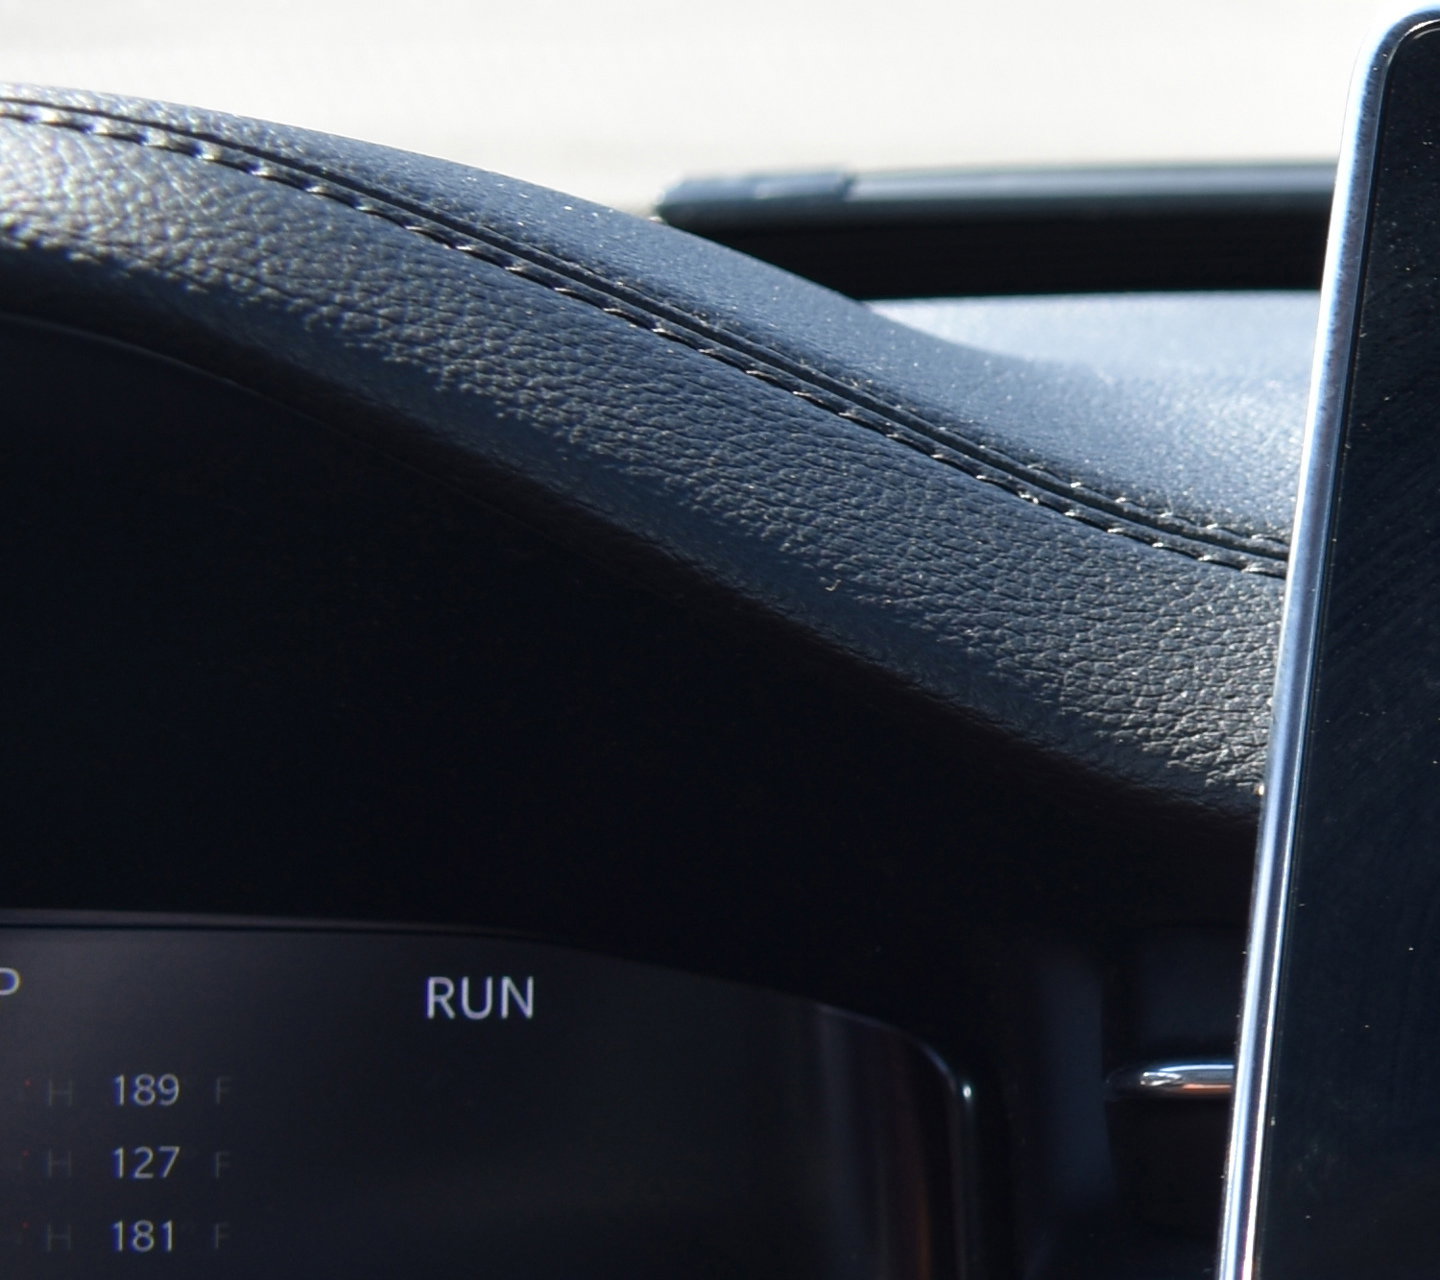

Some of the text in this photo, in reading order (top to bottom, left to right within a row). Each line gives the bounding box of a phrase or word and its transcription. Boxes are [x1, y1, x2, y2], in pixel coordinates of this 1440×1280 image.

[426, 976, 534, 1020] RUN
[113, 1073, 180, 1106] 189
[112, 1145, 180, 1180] 127
[111, 1220, 173, 1253] 181
